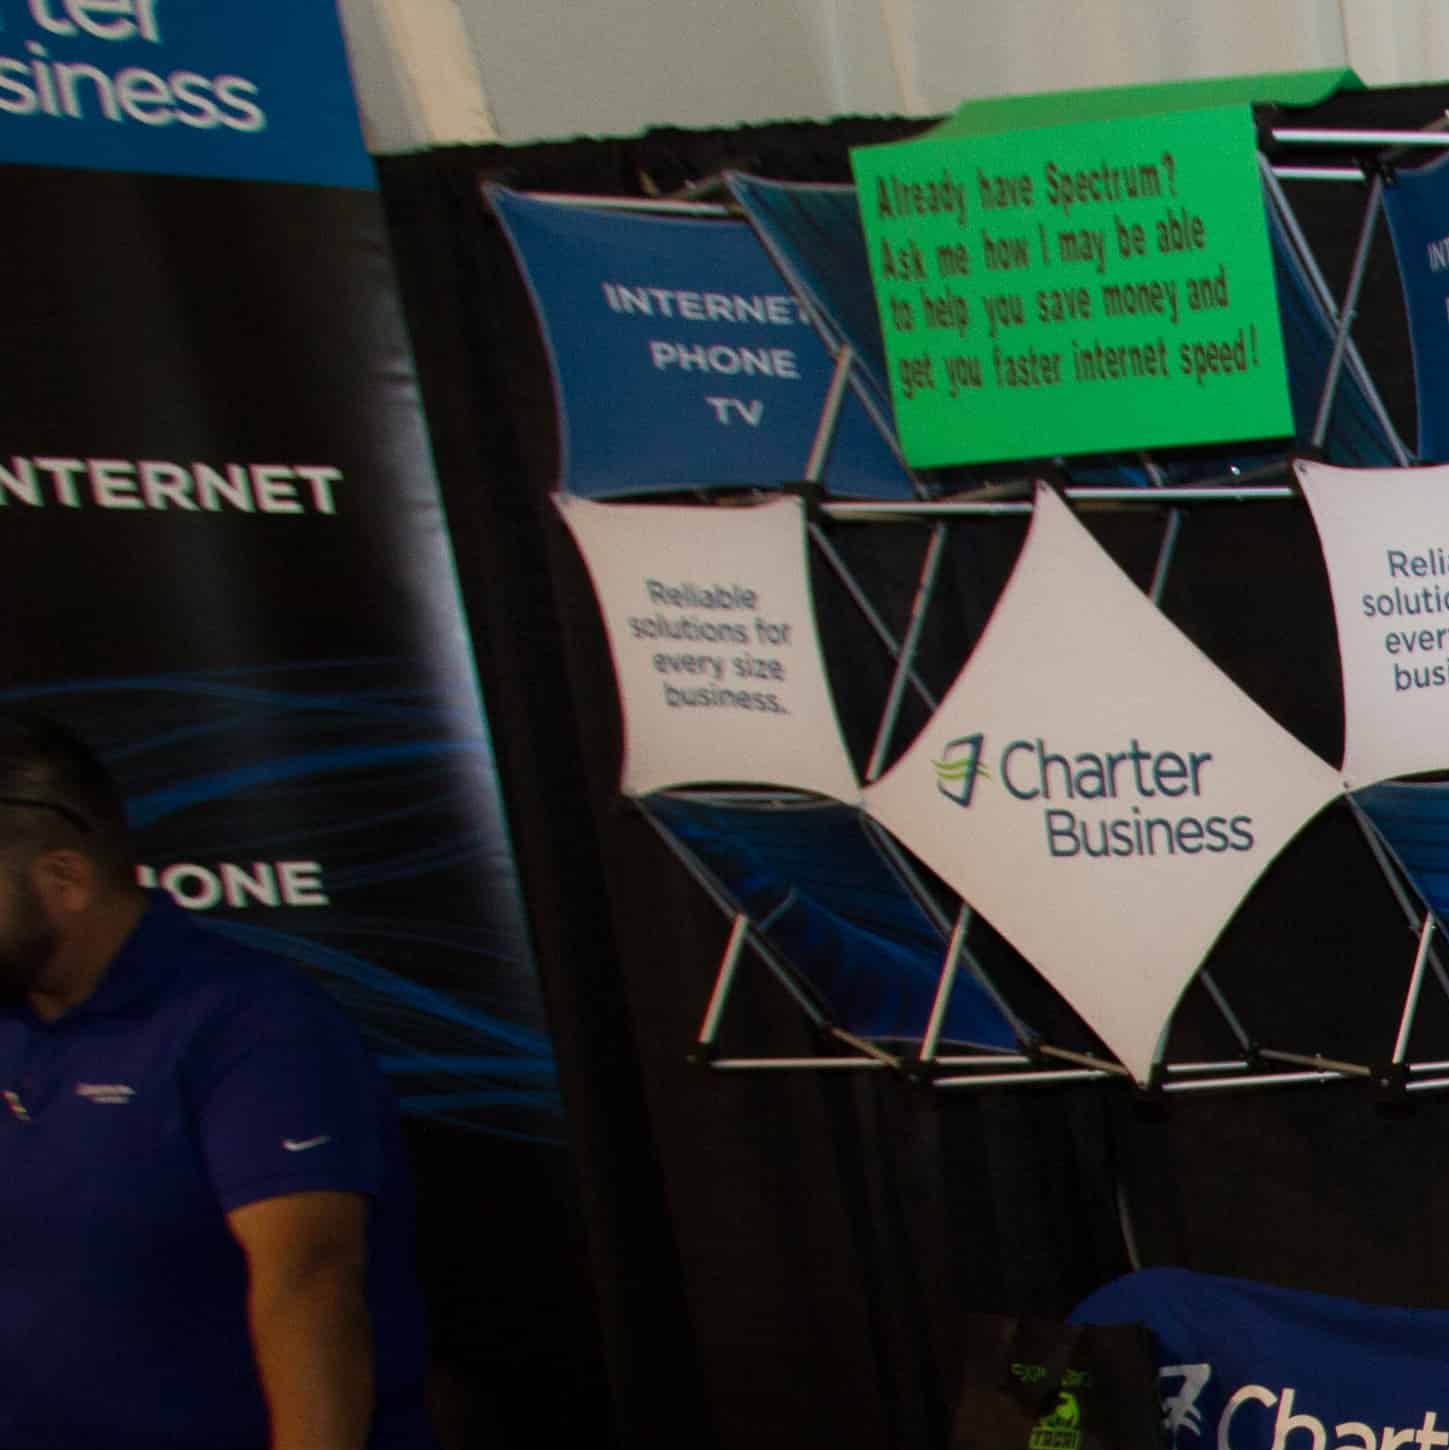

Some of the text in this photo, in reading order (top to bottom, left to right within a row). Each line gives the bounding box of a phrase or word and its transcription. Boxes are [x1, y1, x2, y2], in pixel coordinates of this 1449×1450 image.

[876, 151, 1177, 227] Already have Spectrum?
[881, 206, 1207, 283] Ask me how I may be able
[890, 264, 1230, 338] to help you save money and
[648, 340, 802, 380] PHONE
[898, 324, 1261, 400] get you faster internet speed!
[704, 396, 765, 427] TV
[0, 456, 343, 514] NTERNET
[645, 577, 759, 611] Reliable
[628, 614, 793, 646] solutions for
[652, 651, 787, 682] every size
[663, 681, 790, 715] business.
[1000, 738, 1214, 801] Charter
[1044, 806, 1256, 858] Business
[135, 860, 330, 910] ONE
